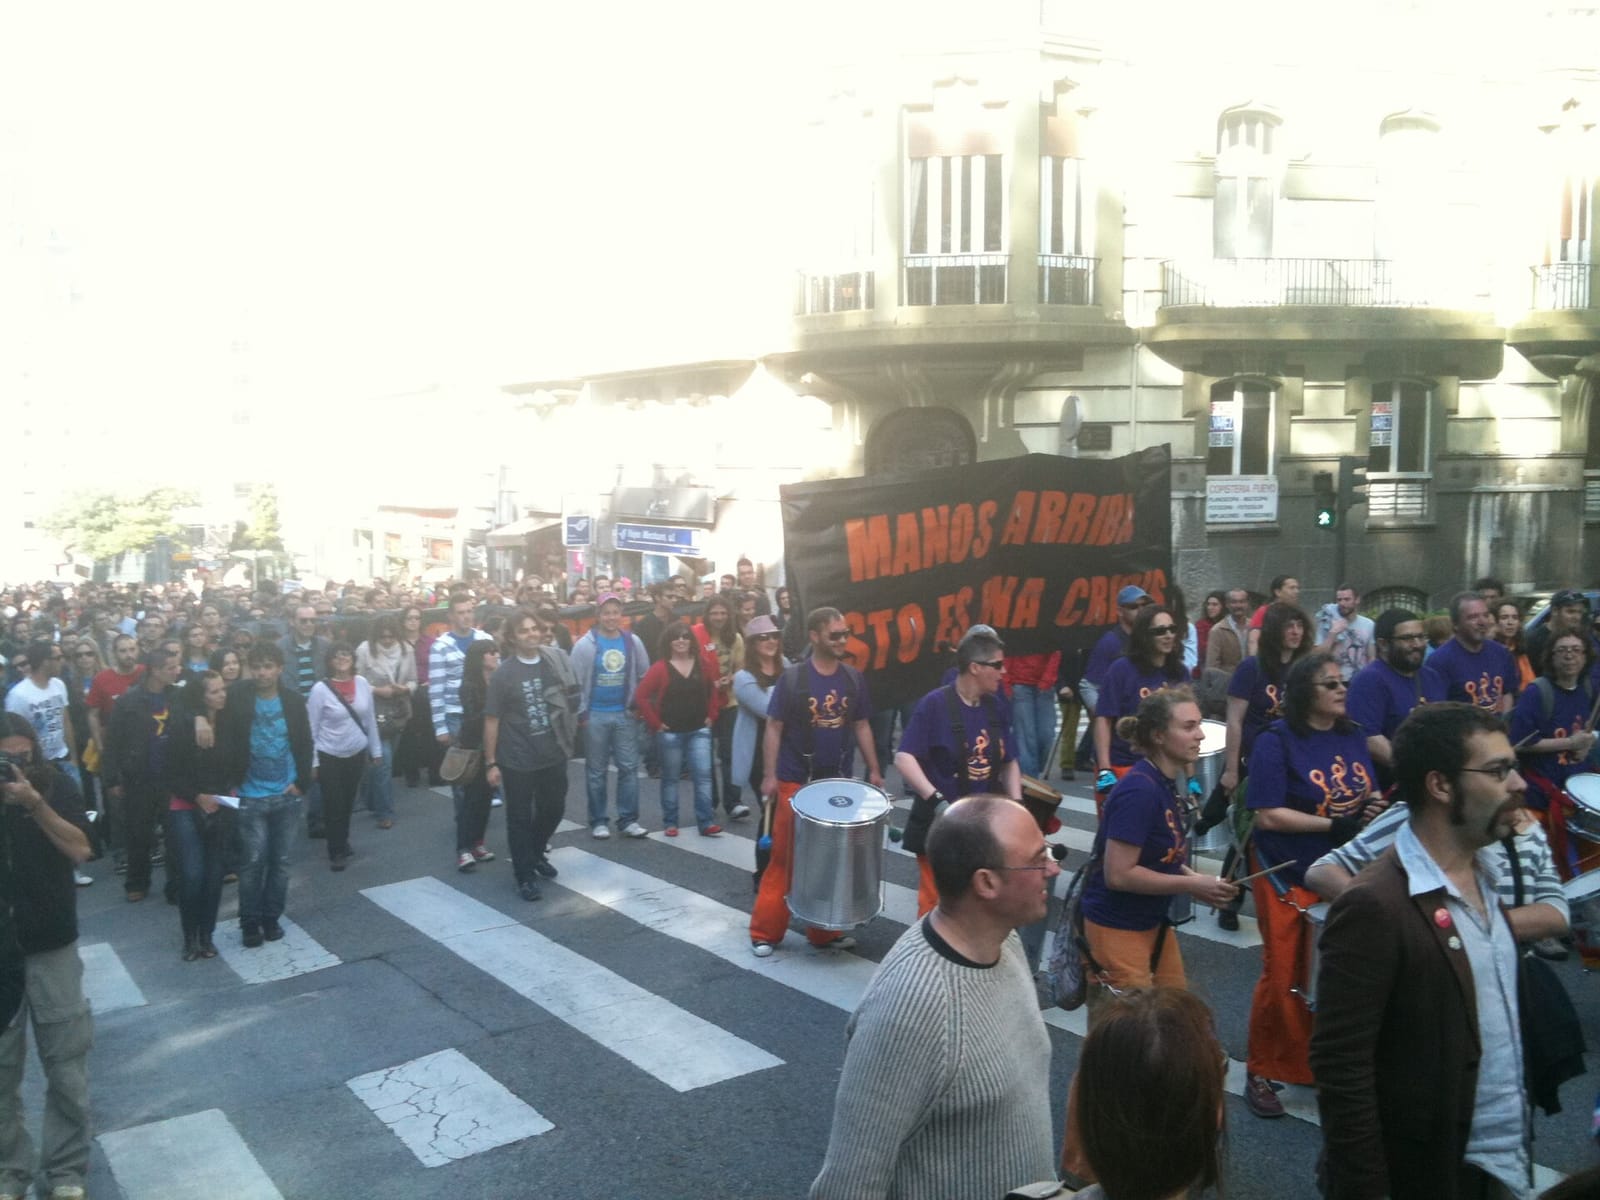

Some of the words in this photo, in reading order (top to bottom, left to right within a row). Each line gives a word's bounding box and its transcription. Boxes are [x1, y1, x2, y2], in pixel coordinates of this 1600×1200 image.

[845, 499, 998, 583] MANOS
[1001, 490, 1136, 546] ARRIBA
[845, 603, 926, 672] STO
[932, 585, 973, 654] ES
